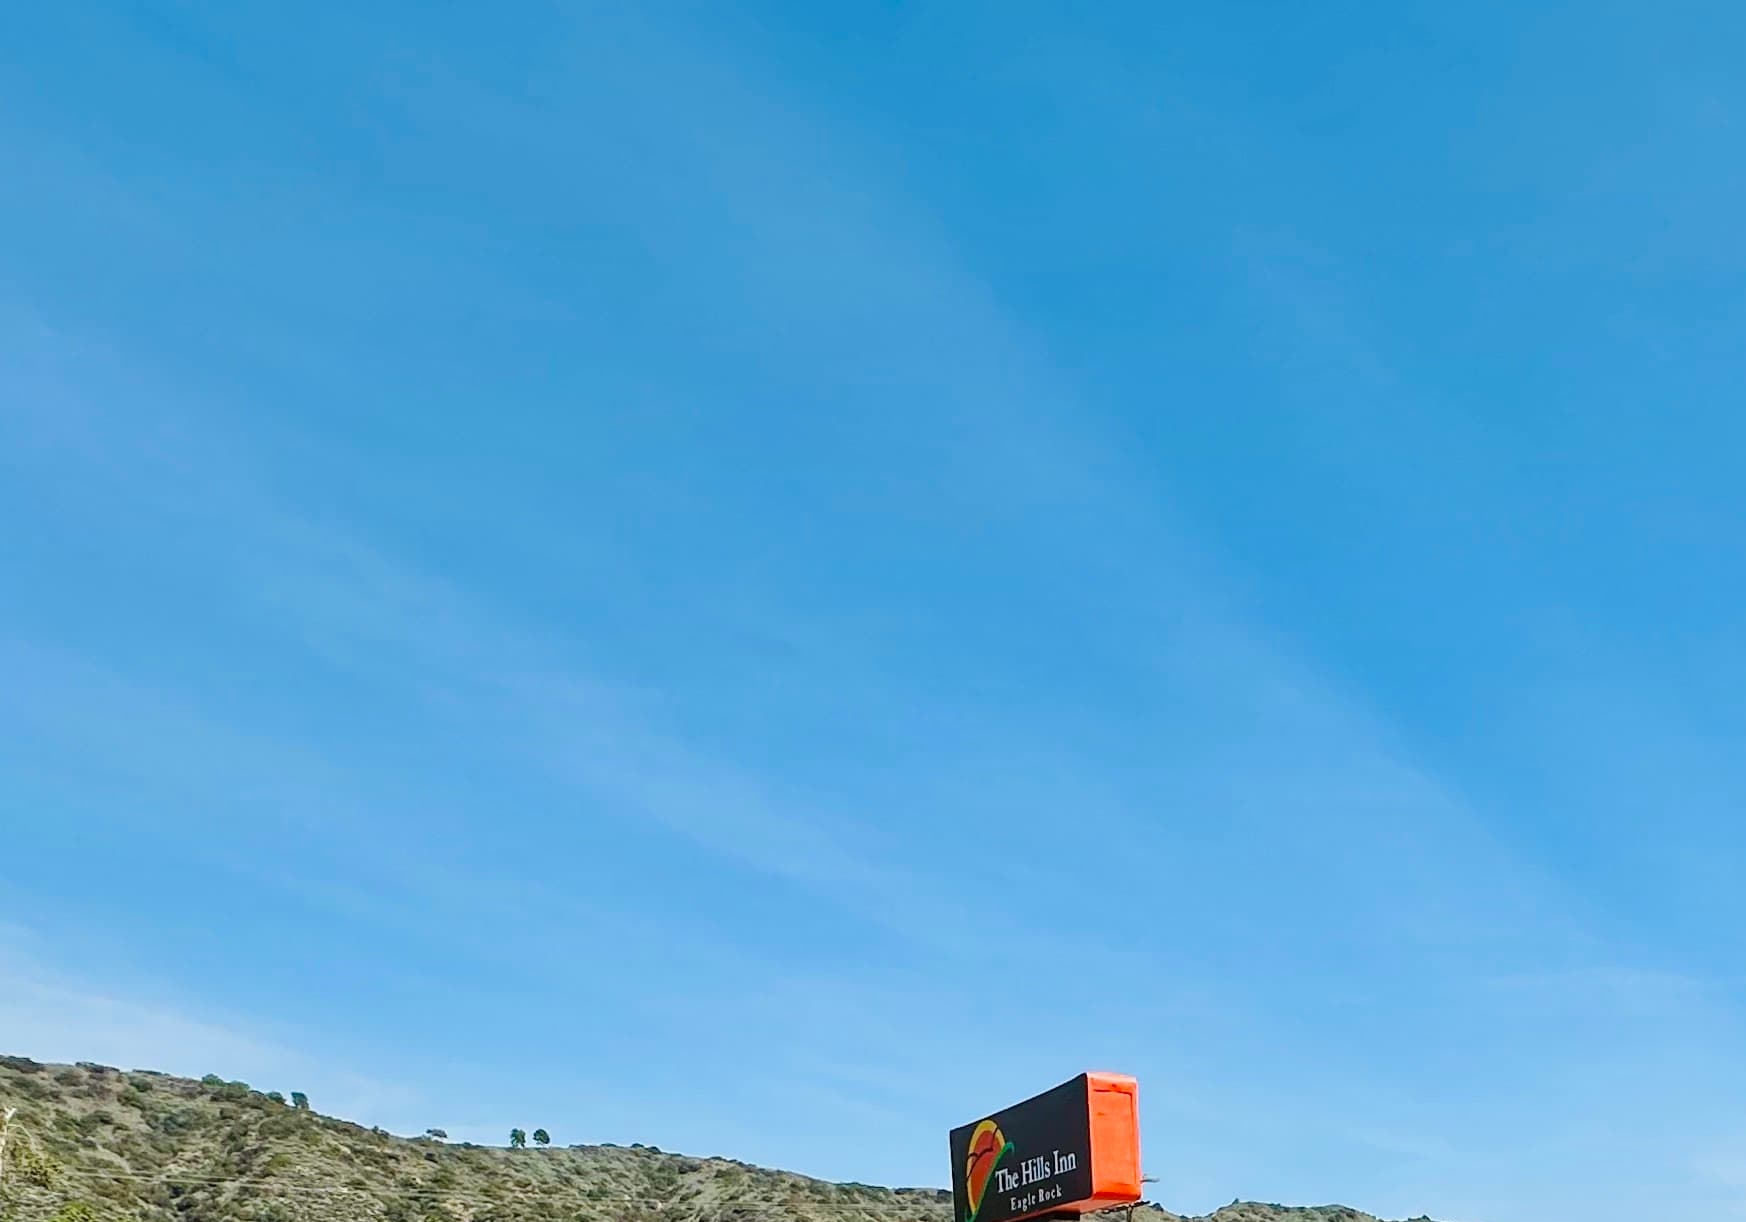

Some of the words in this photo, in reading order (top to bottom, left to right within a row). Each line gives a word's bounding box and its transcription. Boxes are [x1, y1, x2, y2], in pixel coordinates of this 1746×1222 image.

[995, 1167, 1019, 1193] The
[1021, 1156, 1050, 1186] Hills
[1052, 1150, 1077, 1175] Inn
[1010, 1193, 1036, 1212] Eagle
[1038, 1184, 1062, 1203] Rock
